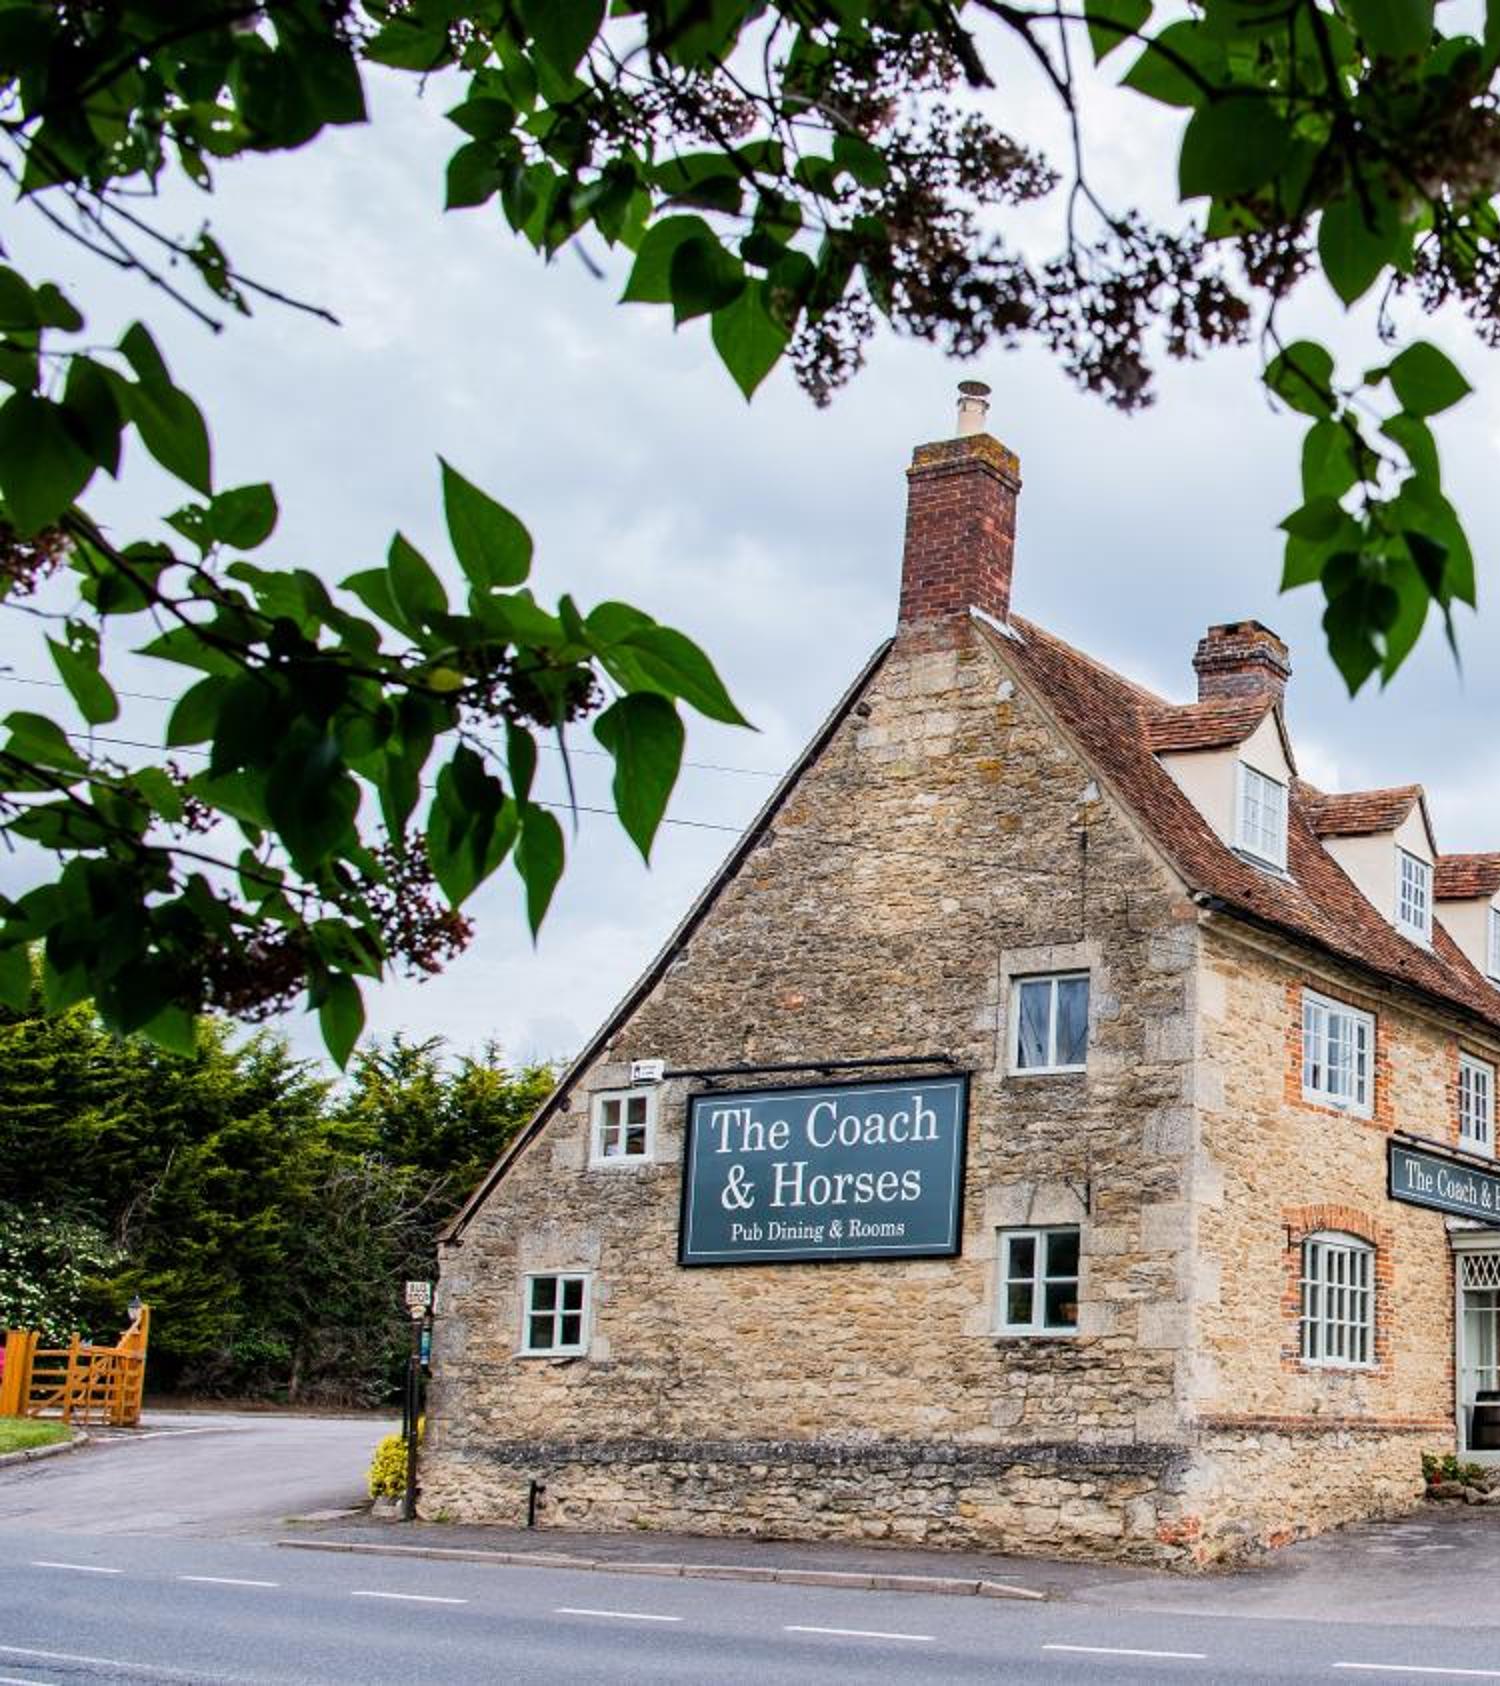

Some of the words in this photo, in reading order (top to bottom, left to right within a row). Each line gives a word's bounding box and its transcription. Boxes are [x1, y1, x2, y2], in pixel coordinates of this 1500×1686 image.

[711, 1108, 790, 1153] The
[806, 1095, 940, 1148] Coach
[720, 1163, 755, 1210] &
[769, 1160, 922, 1208] Horses
[1405, 1159, 1433, 1193] The
[1437, 1168, 1478, 1205] Coach
[1481, 1181, 1492, 1209] &
[731, 1222, 763, 1242] Pub
[767, 1221, 823, 1243] Dining
[829, 1219, 843, 1238] &
[849, 1219, 905, 1237] Rooms
